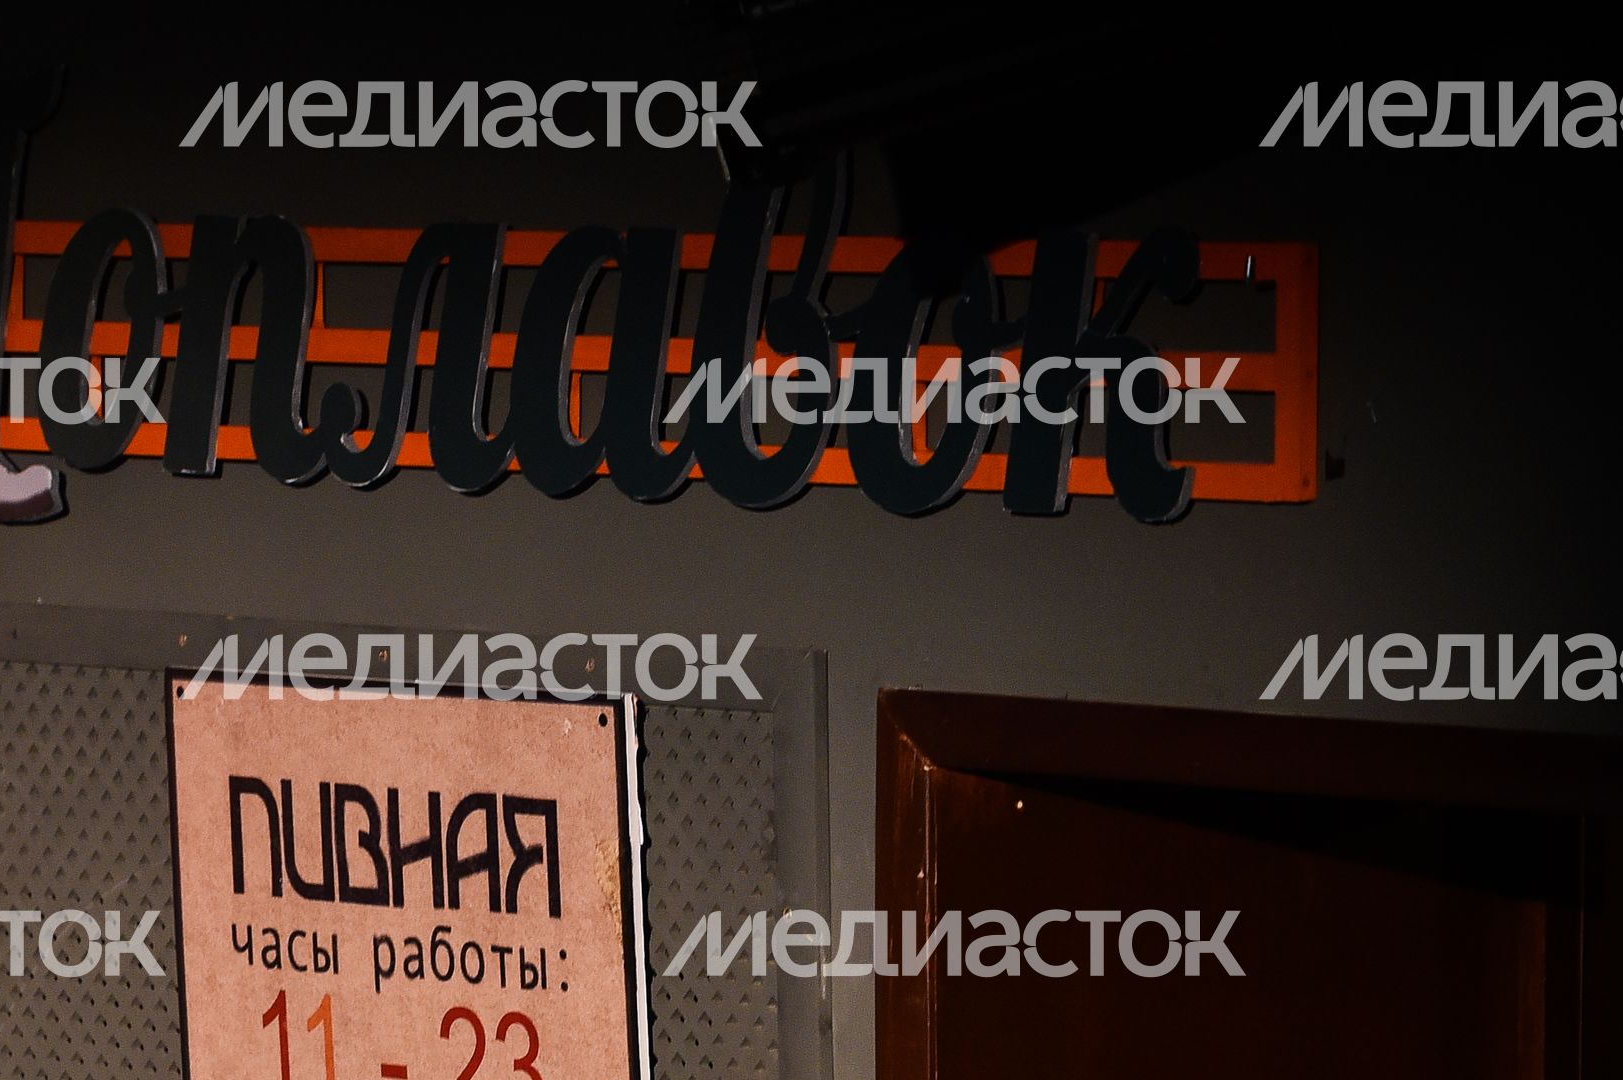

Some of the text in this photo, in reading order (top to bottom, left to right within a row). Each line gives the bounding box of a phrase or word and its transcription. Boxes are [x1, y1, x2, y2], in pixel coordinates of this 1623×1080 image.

[229, 775, 561, 918] ПИВНАЯ
[232, 924, 570, 993] часы работы:
